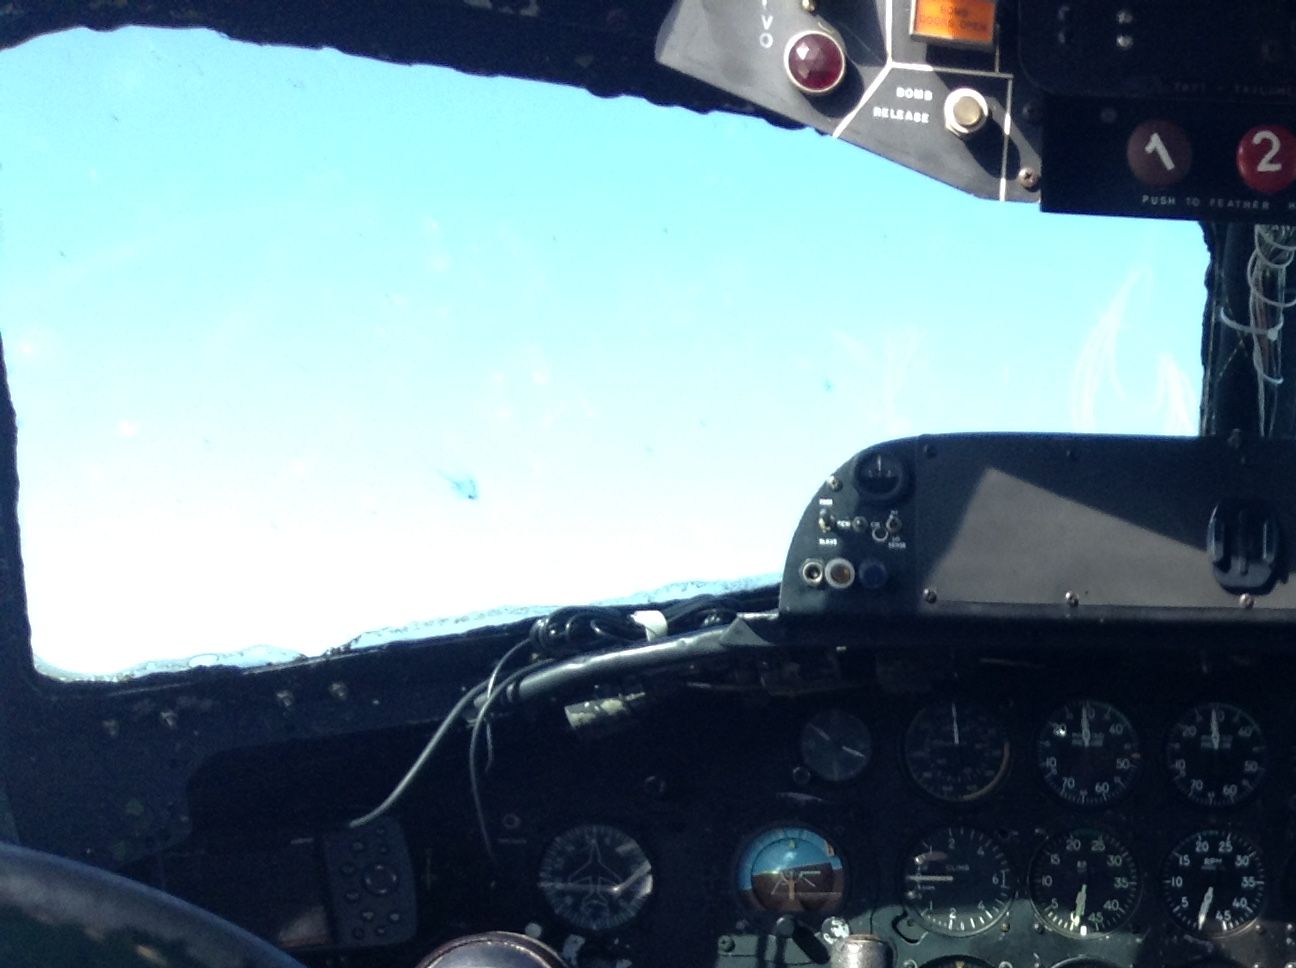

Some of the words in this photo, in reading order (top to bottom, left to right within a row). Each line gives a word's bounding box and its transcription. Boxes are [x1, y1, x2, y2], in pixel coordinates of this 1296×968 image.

[896, 86, 933, 101] BOMB
[873, 106, 929, 124] RELEASE
[1145, 132, 1176, 171] 1
[1252, 130, 1283, 173] 2
[1142, 194, 1176, 206] PUSH
[1186, 197, 1200, 207] TO
[1209, 198, 1271, 210] FEATHER
[1116, 758, 1131, 770] 50
[1244, 760, 1258, 772] 50
[1062, 776, 1076, 789] 70
[1095, 781, 1110, 793] 60
[1190, 778, 1204, 791] 70
[1222, 784, 1238, 796] 60
[1066, 840, 1082, 851] 20
[1194, 840, 1210, 852] 20
[1218, 840, 1233, 852] 25
[1107, 854, 1122, 866] 30
[1179, 854, 1190, 866] 15
[1234, 854, 1250, 867] 30
[1041, 875, 1053, 886] 10
[1113, 876, 1129, 888] 35
[1170, 875, 1183, 888] 10
[1241, 876, 1257, 888] 35
[1103, 899, 1120, 911] 40
[1182, 896, 1190, 908] 5
[1232, 896, 1248, 909] 40
[1215, 910, 1232, 922] 45
